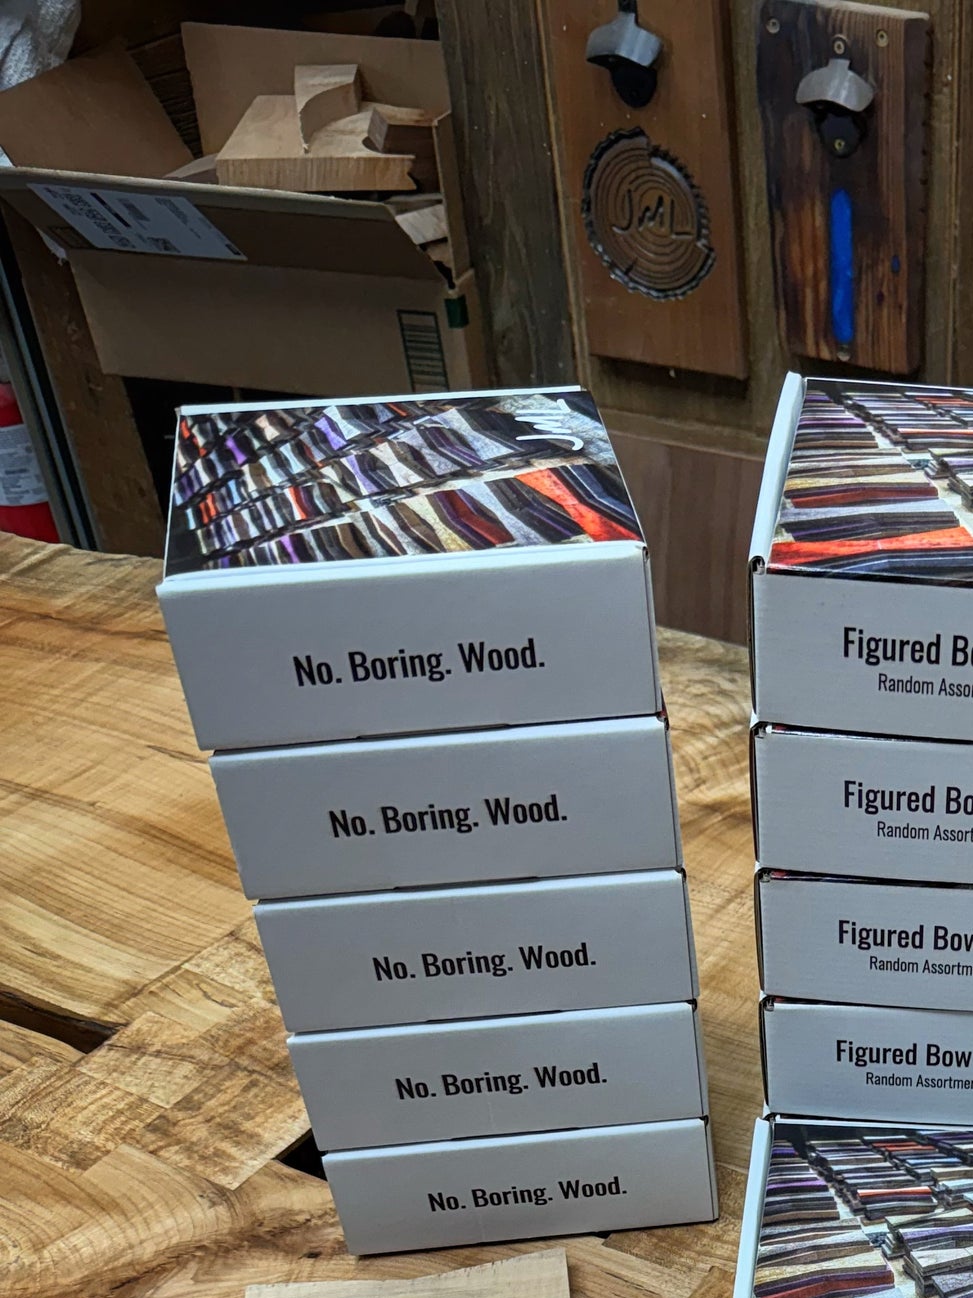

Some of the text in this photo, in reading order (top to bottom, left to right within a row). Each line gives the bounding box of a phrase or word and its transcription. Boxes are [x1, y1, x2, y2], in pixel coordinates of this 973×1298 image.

[293, 638, 544, 686] No. Boring. Wood.
[844, 627, 941, 666] Figured
[879, 673, 933, 695] Random
[844, 780, 935, 815] Figured
[329, 794, 567, 837] No. Boring. Wood.
[878, 821, 929, 840] Random
[839, 920, 924, 950] Figured
[373, 943, 596, 981] No. Boring. Wood.
[870, 956, 918, 972] Random
[837, 1040, 917, 1067] Figured
[927, 1044, 972, 1067] Bow
[395, 1063, 607, 1099] No. Boring. Wood.
[866, 1072, 912, 1086] Random
[428, 1176, 627, 1211] No. Boring. Wood.
